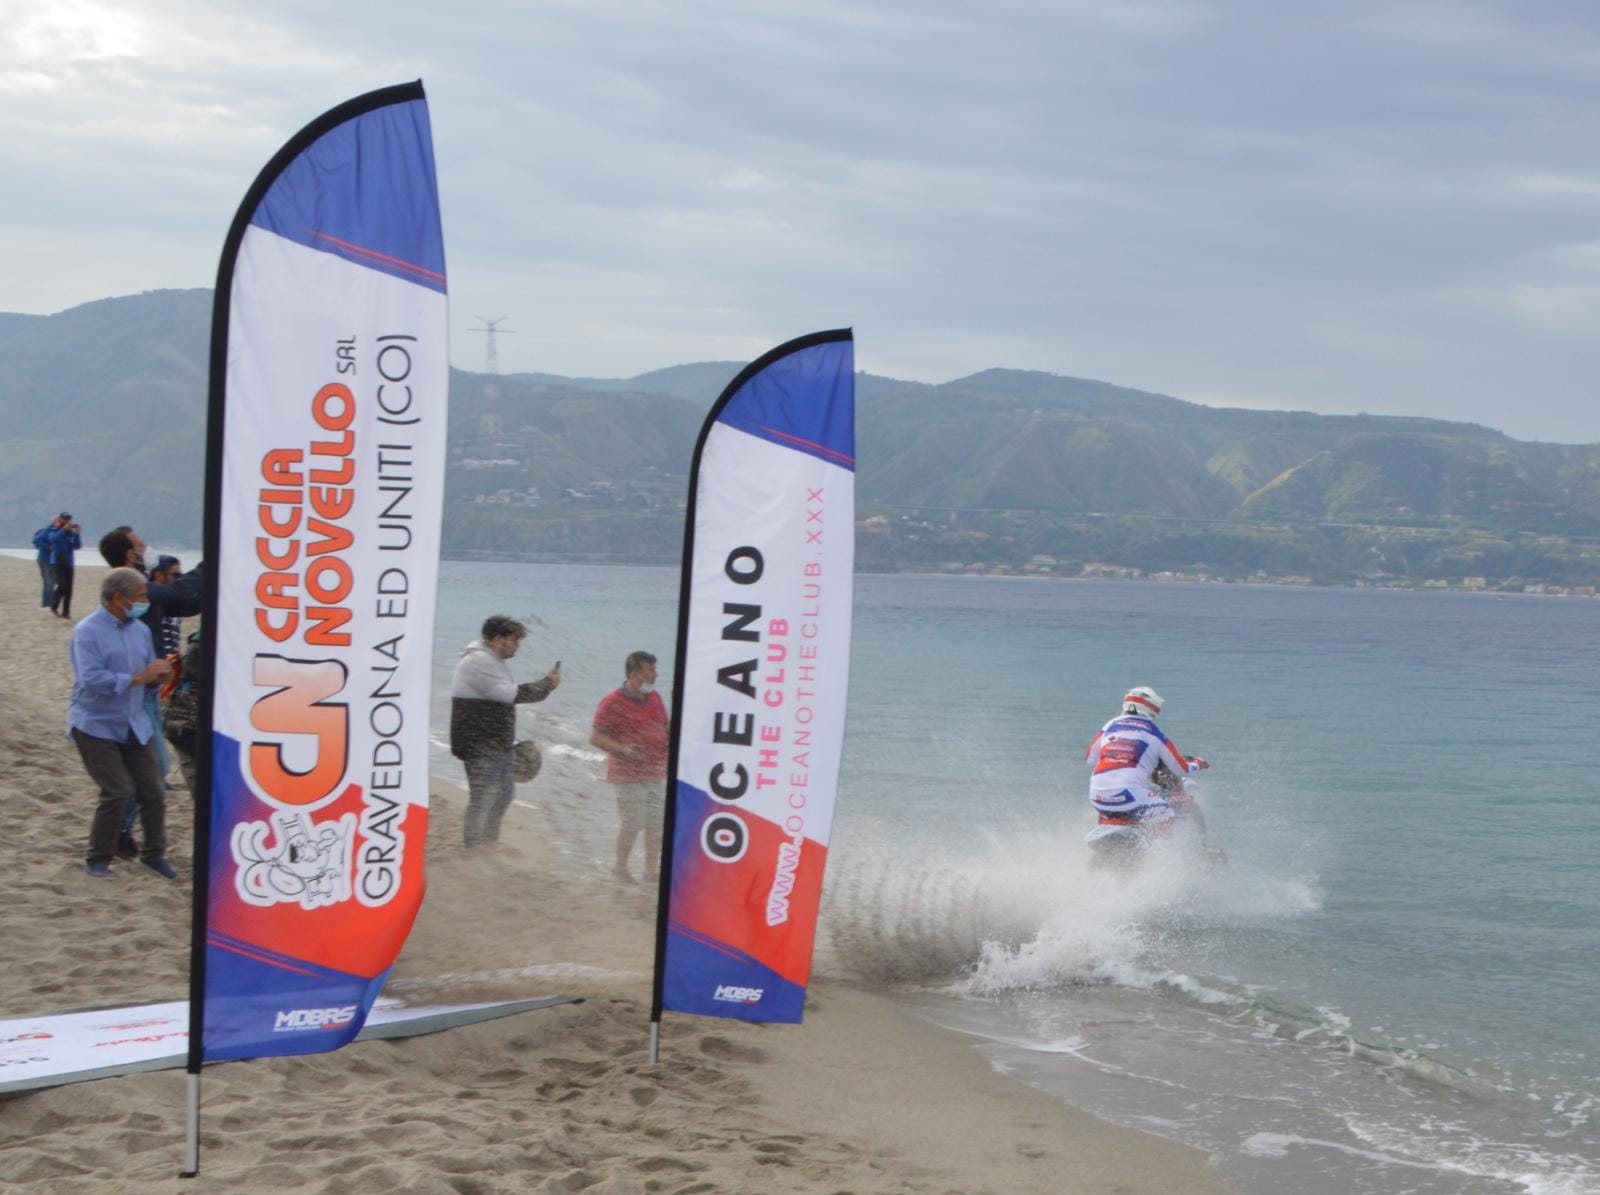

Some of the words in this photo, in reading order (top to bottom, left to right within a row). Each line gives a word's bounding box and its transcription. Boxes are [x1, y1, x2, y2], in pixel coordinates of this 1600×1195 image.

[376, 335, 421, 425] (CO)
[303, 382, 356, 647] NOVELLO
[335, 334, 357, 376] SRL
[377, 444, 413, 551] UNITI
[254, 448, 304, 643] CACCIA
[376, 567, 409, 618] ED
[706, 545, 765, 859] OCEANO
[763, 618, 789, 708] CLUB
[362, 633, 406, 900] GRAVEDONA
[756, 725, 782, 790] THE
